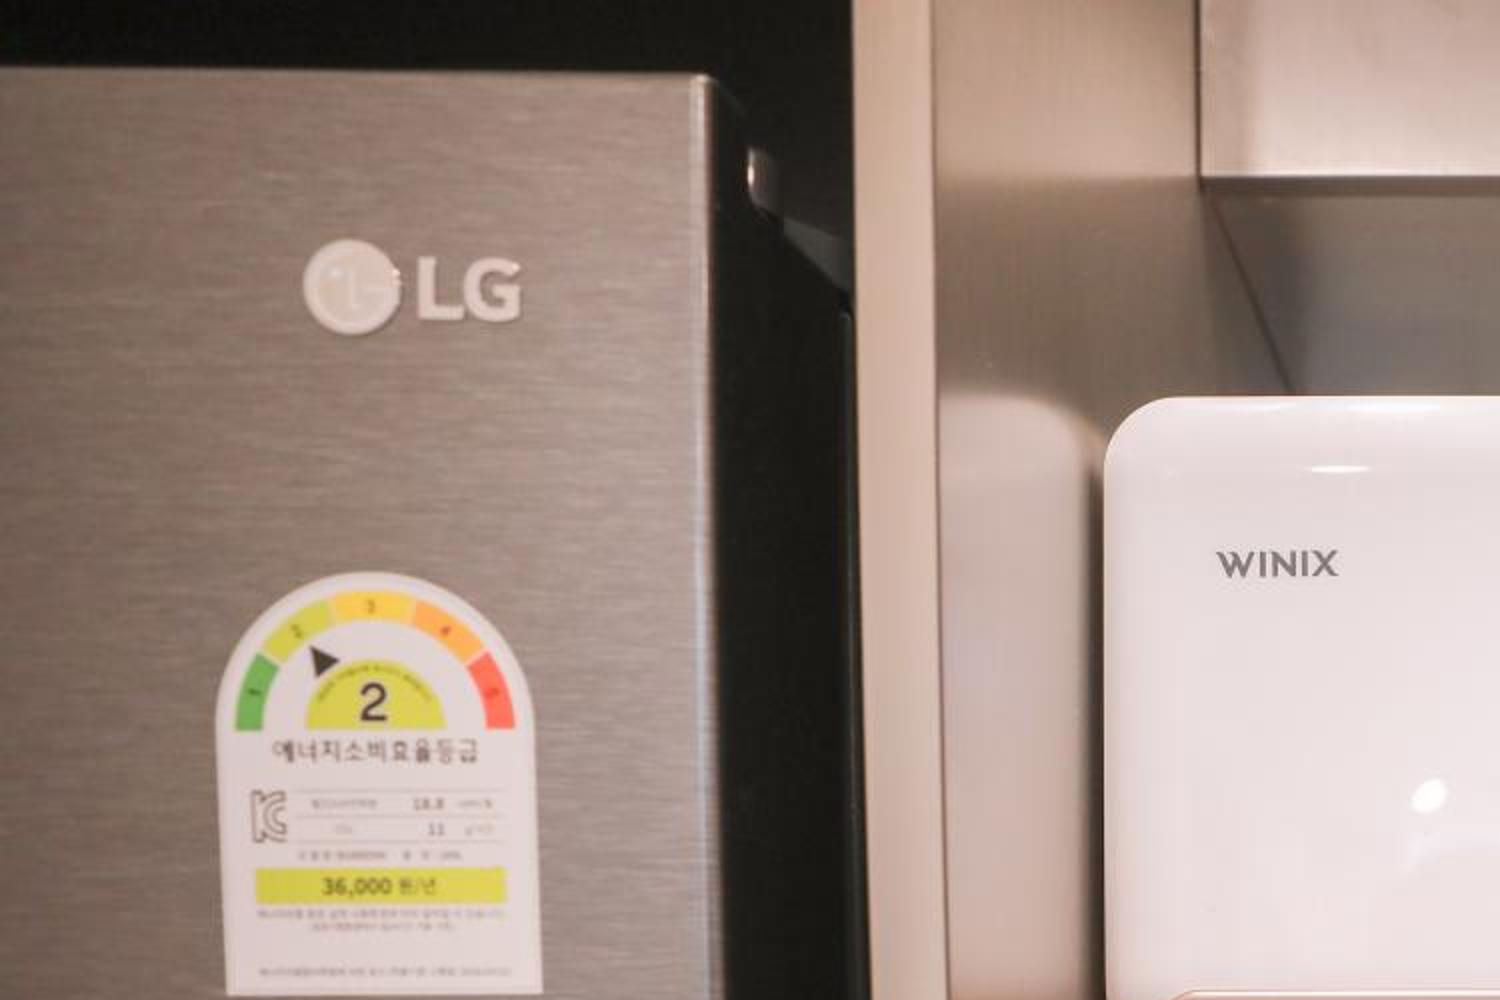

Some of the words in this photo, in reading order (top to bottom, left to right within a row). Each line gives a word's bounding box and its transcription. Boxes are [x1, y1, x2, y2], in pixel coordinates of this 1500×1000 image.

[418, 256, 521, 322] LG
[1216, 549, 1339, 579] WINIX
[359, 682, 388, 721] 2
[272, 738, 478, 763] 에너지소비효율등급
[322, 877, 392, 898] 36,000
